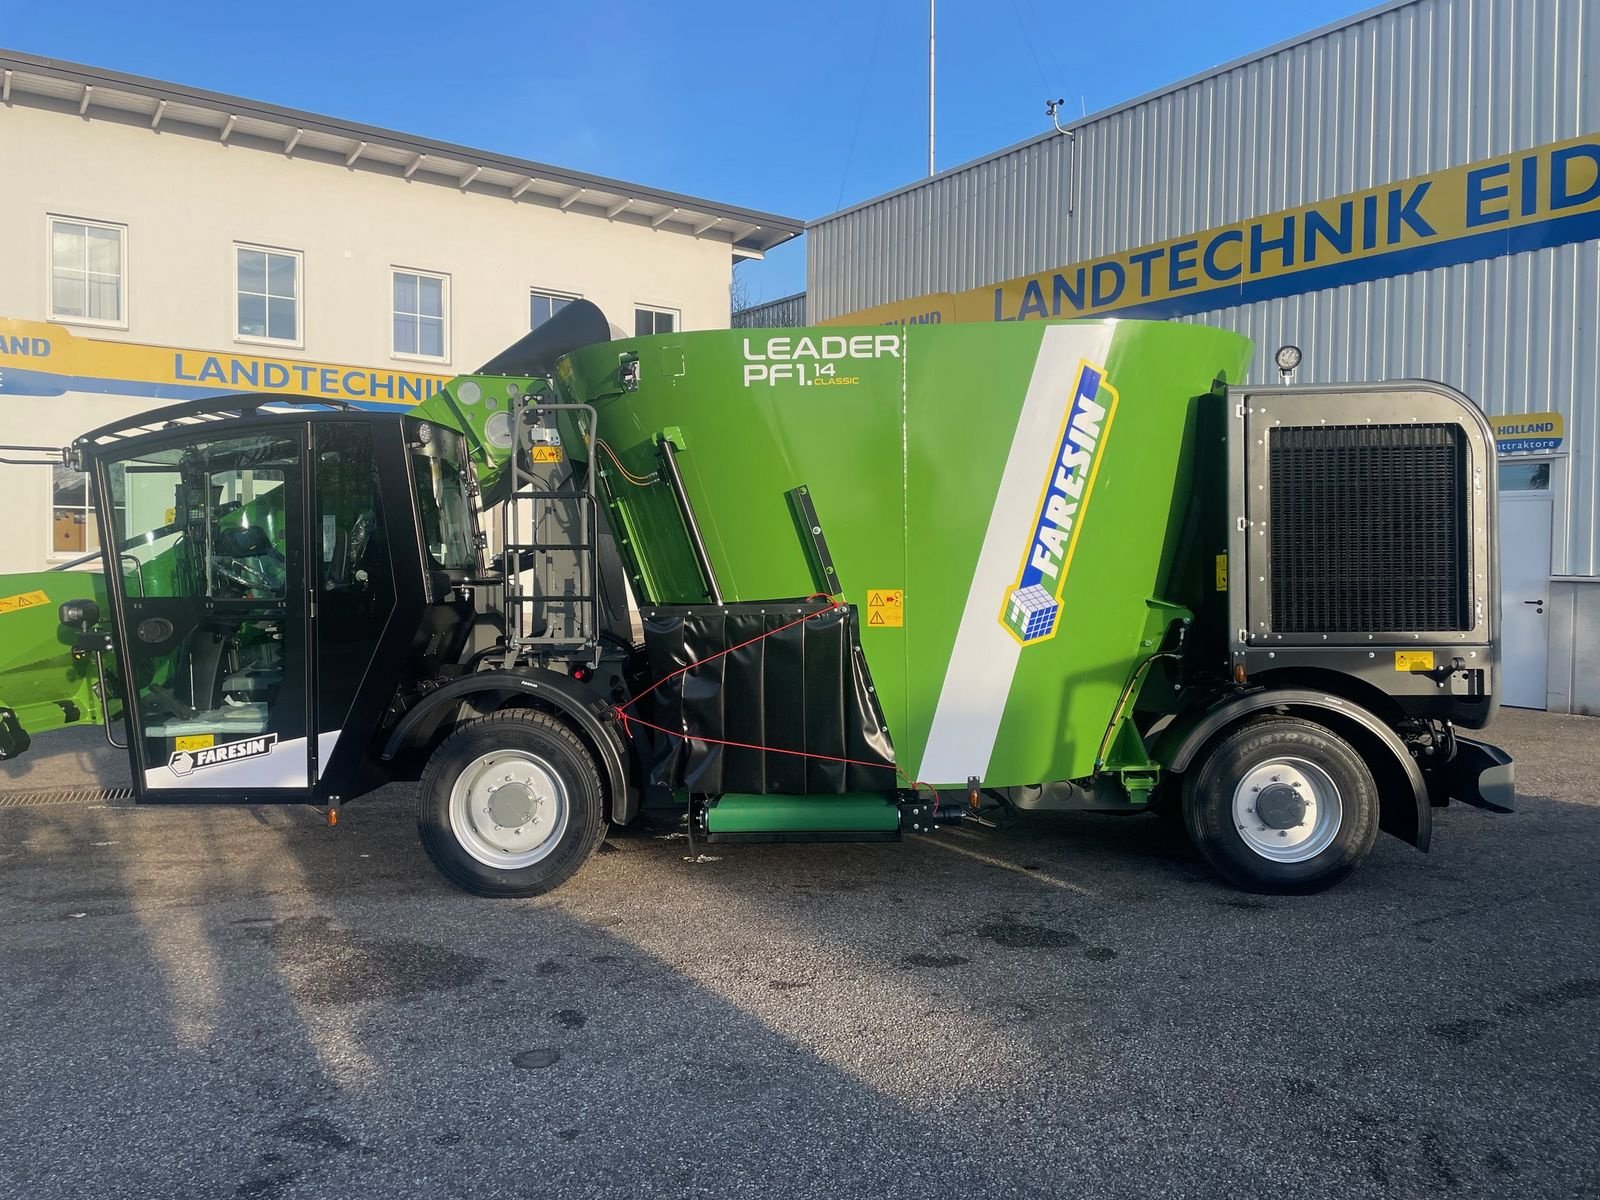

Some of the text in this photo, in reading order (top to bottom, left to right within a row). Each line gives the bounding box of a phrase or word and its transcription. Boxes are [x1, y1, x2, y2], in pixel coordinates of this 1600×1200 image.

[994, 143, 1600, 321] LANDTECHNIK EID
[744, 336, 900, 360] LEADER
[814, 377, 860, 386] CLASSIC
[1497, 422, 1554, 435] HOLLAND
[1031, 393, 1106, 580] FARESIN
[197, 738, 265, 766] FARESIN
